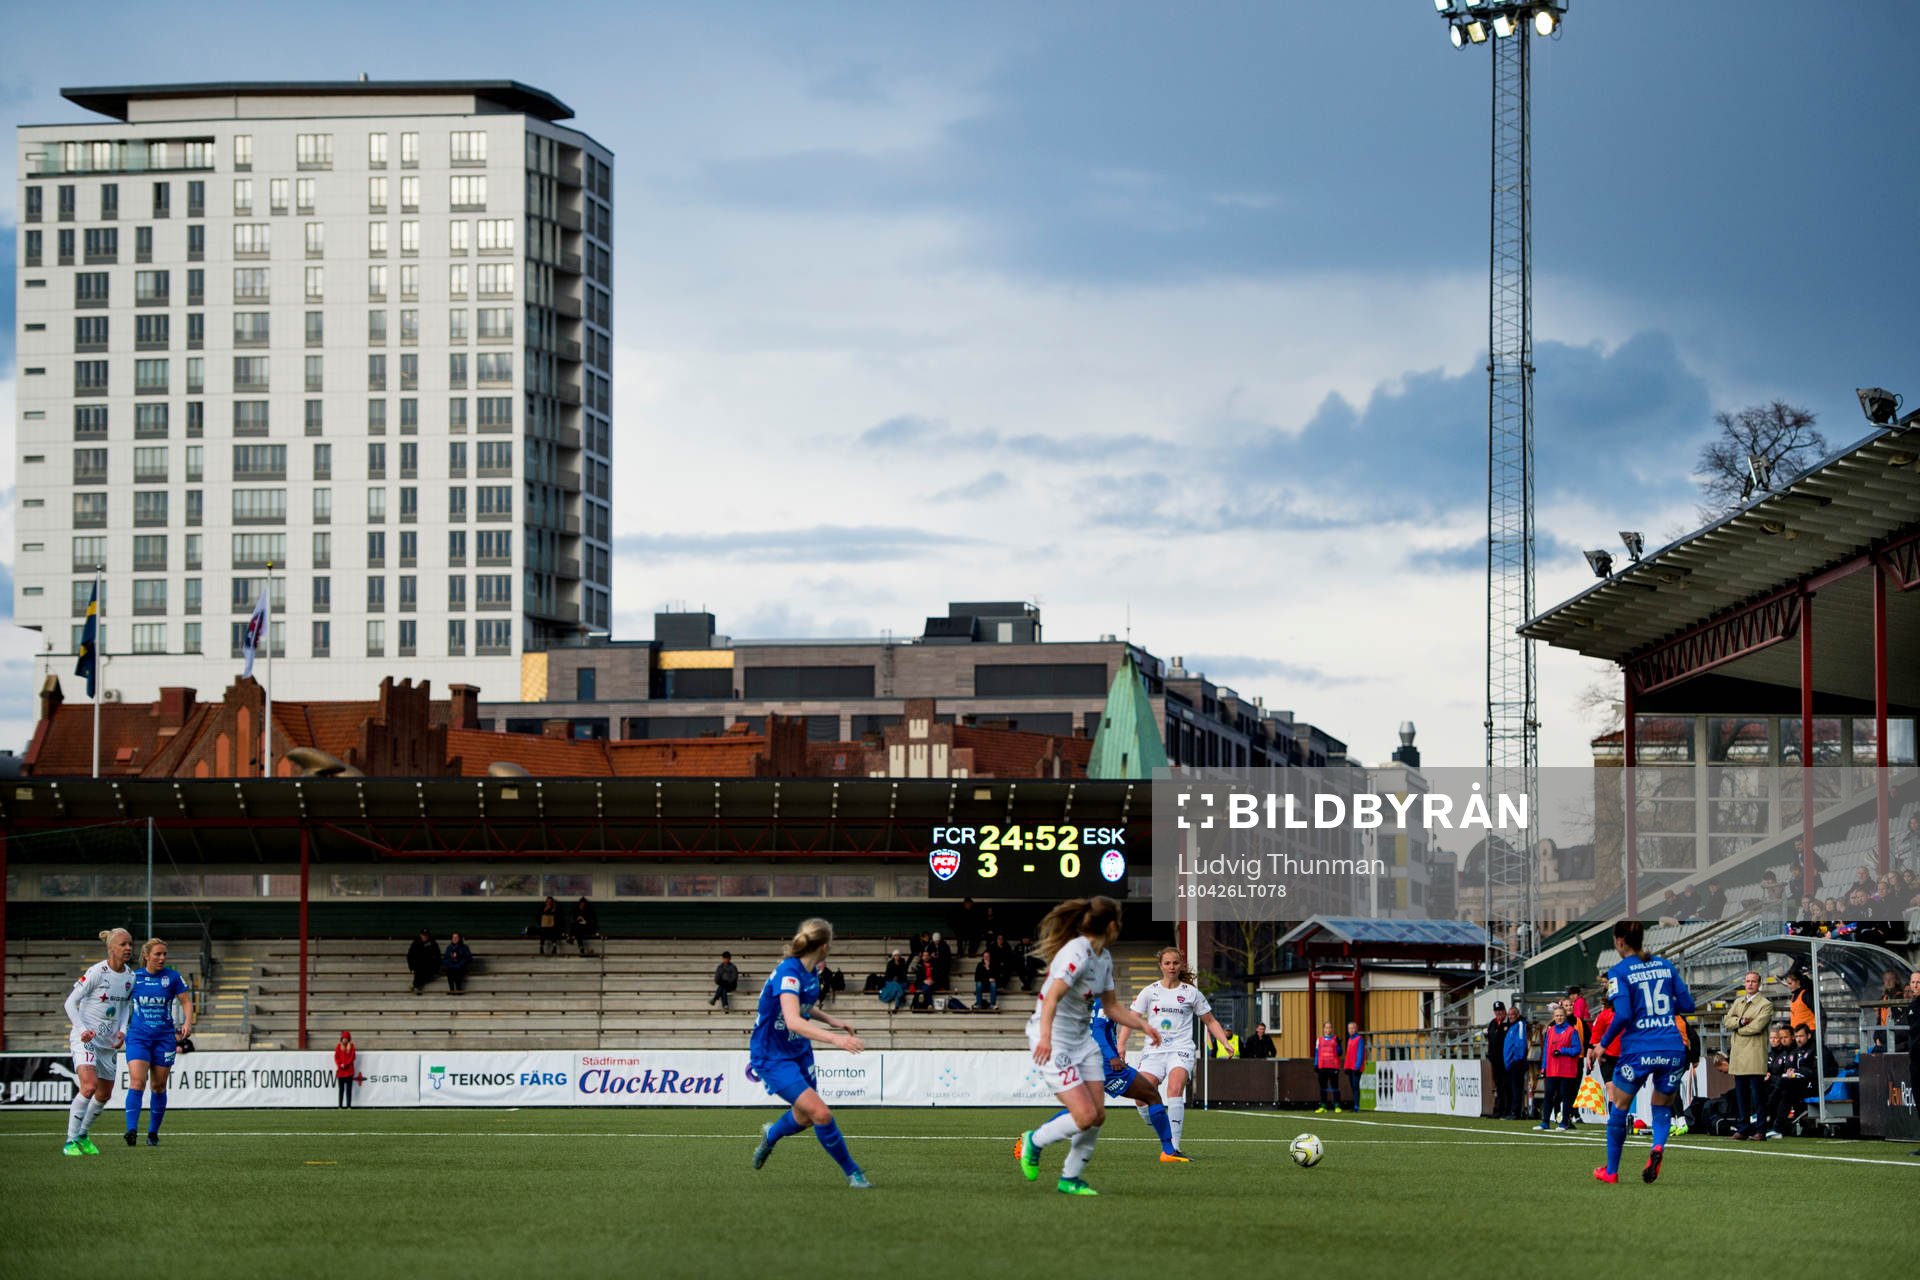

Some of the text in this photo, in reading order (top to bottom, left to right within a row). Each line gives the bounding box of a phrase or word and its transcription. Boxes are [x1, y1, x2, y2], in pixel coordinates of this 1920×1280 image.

[933, 825, 1126, 850] FCR 24:52 ESK
[977, 853, 999, 878] 3
[1060, 853, 1081, 878] 0
[1639, 979, 1670, 1016] 16
[85, 1051, 94, 1062] 17
[582, 1056, 640, 1066] Städfirman
[180, 1072, 190, 1090] A
[195, 1070, 246, 1090] BETTER
[251, 1069, 338, 1089] TOMORROW
[450, 1069, 567, 1086] TEKNOS FÄRG
[578, 1069, 724, 1095] ClockRent
[1058, 1065, 1080, 1086] 22
[10, 1081, 72, 1102] PUMA
[822, 1088, 866, 1098] for growth
